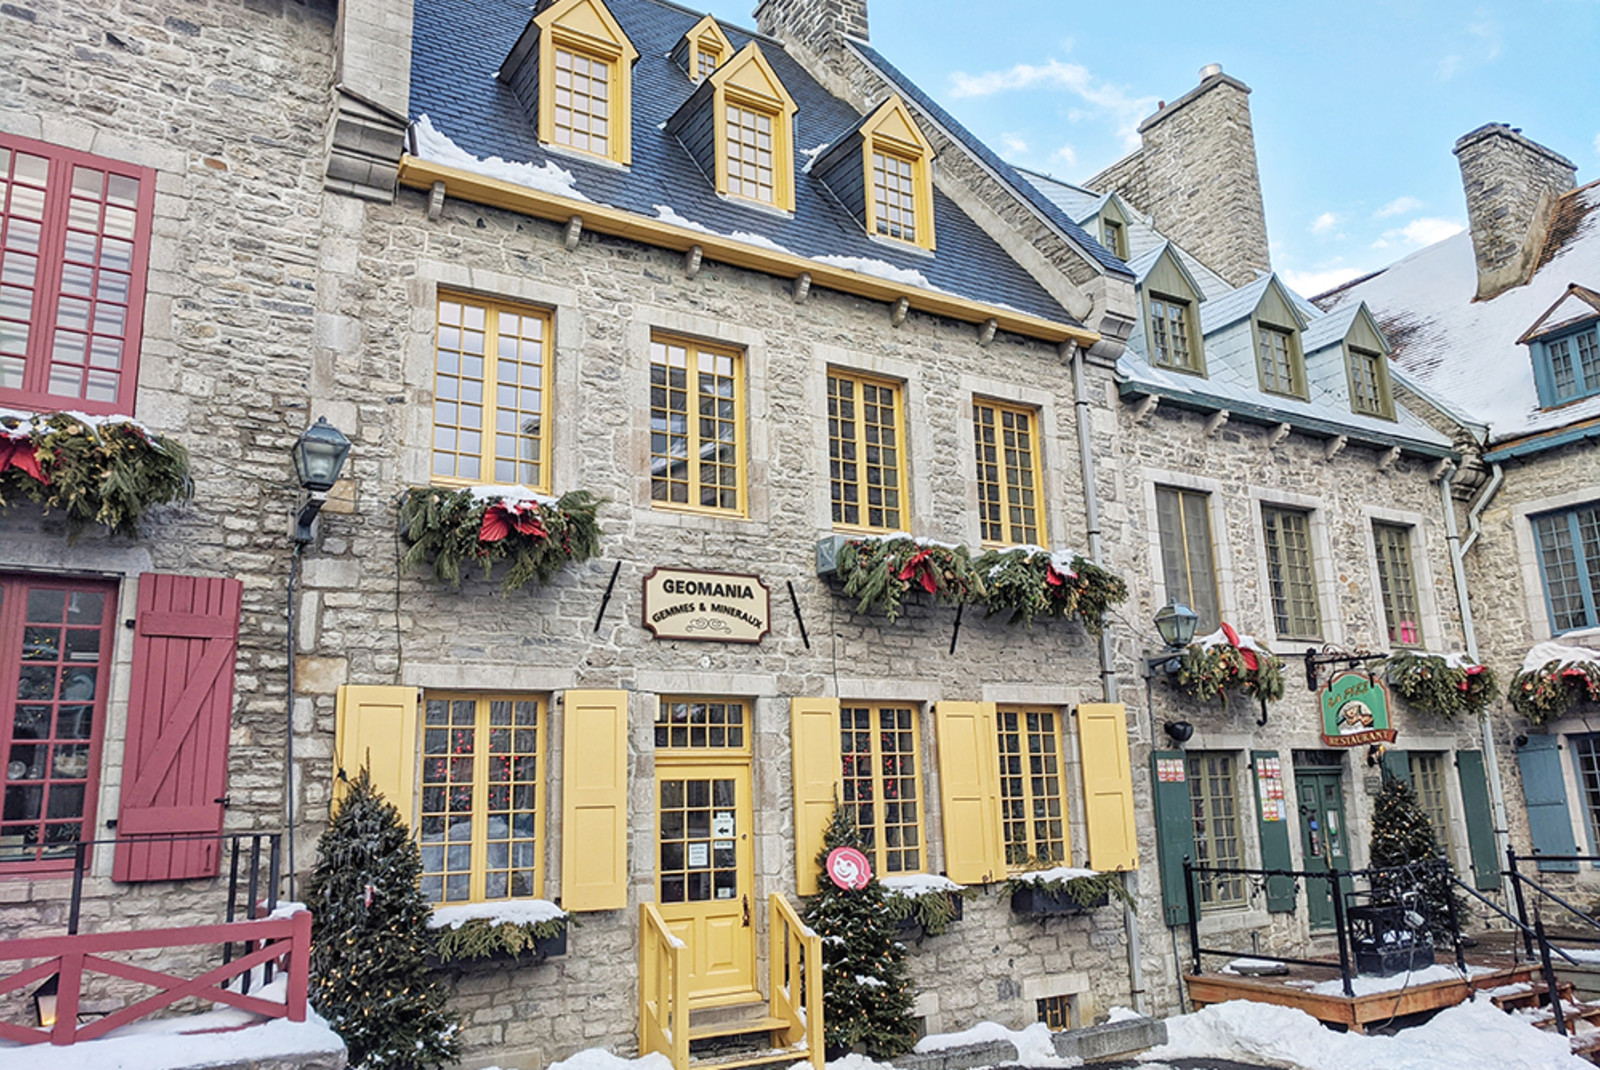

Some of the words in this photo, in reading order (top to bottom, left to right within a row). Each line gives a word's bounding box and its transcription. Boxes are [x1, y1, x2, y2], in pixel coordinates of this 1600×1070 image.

[662, 579, 754, 600] GEOMANIA
[652, 602, 695, 623] GEMMES
[698, 602, 706, 612] &
[711, 603, 763, 629] MINERAUX
[1329, 731, 1389, 745] RESTAURANT
